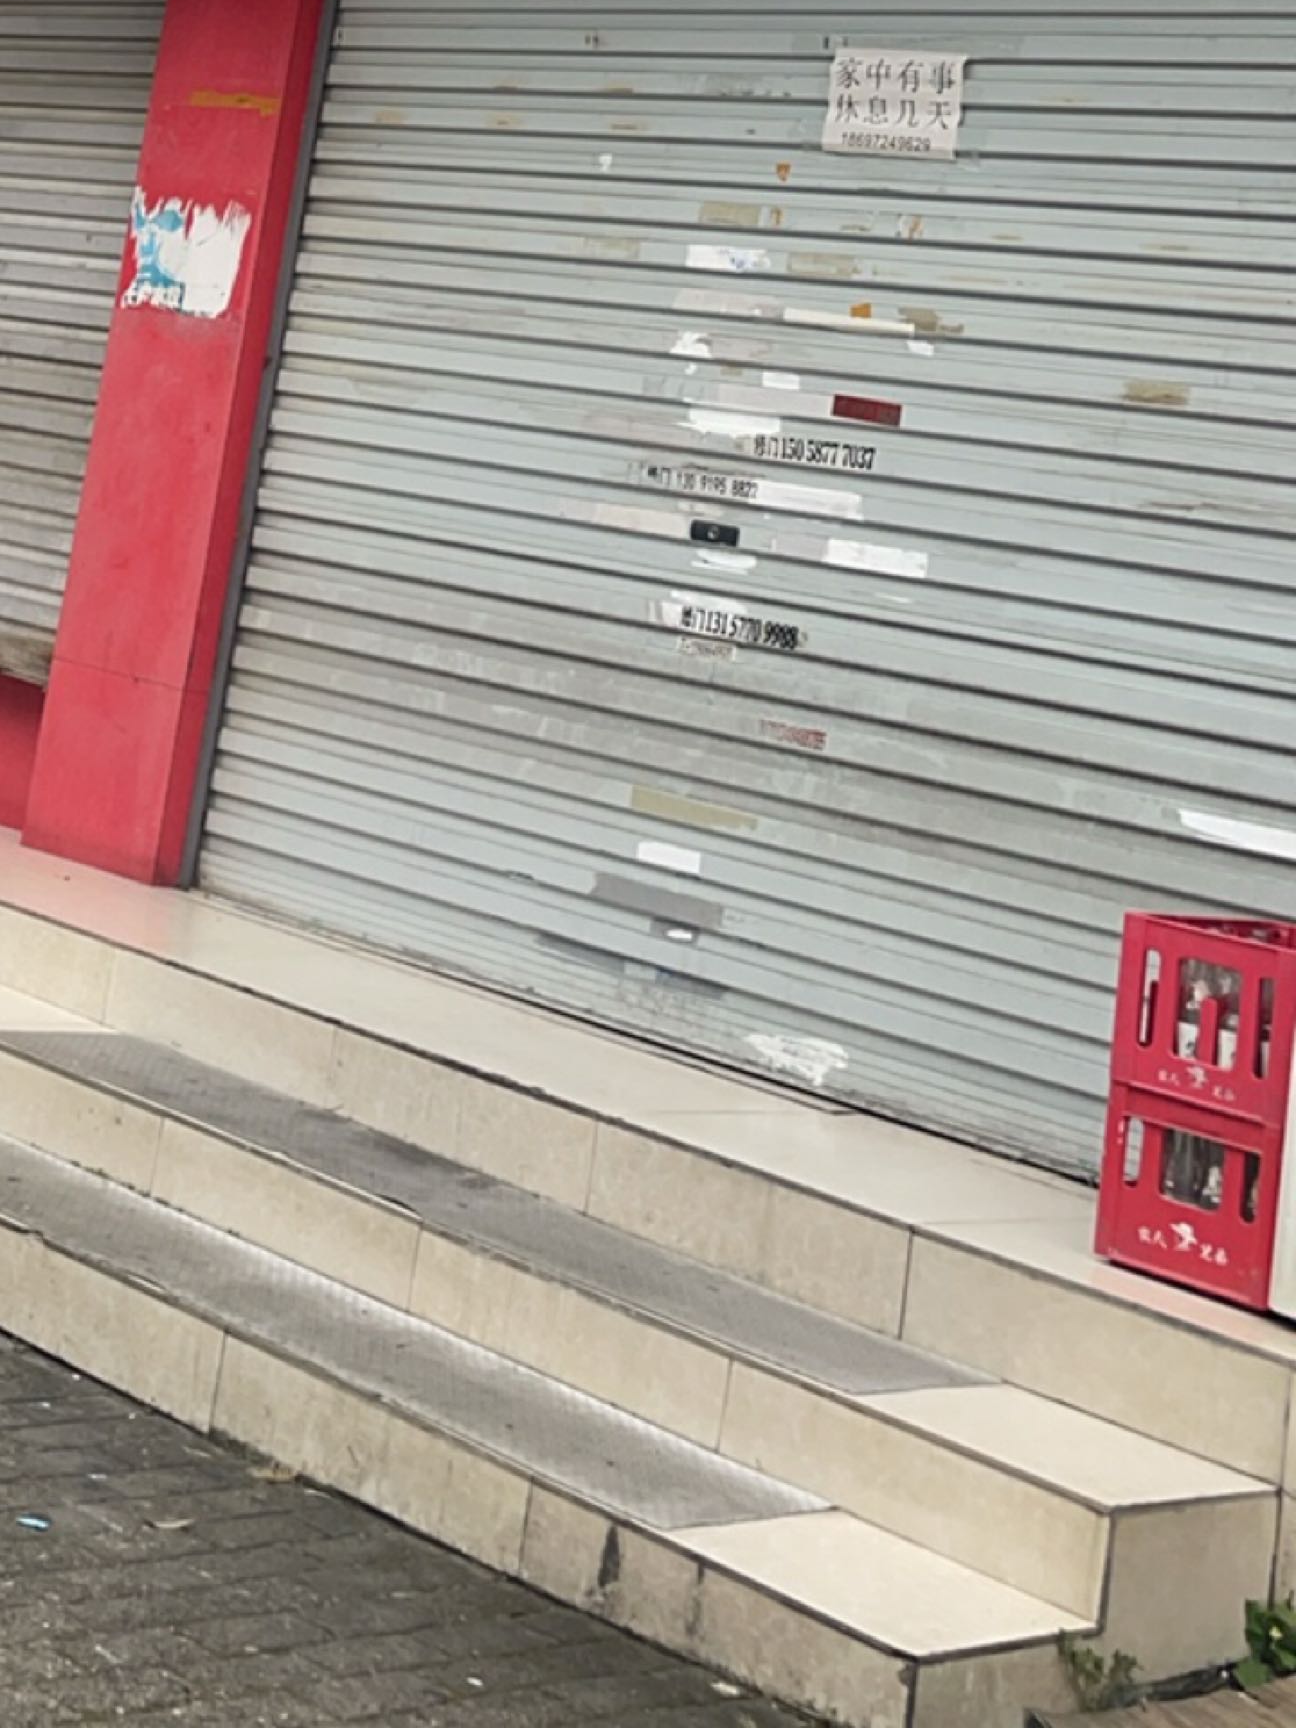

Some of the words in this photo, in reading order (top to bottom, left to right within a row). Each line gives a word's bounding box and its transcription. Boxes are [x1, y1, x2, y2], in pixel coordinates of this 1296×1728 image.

[836, 57, 956, 95] 家中有事
[834, 93, 953, 130] 休息几天
